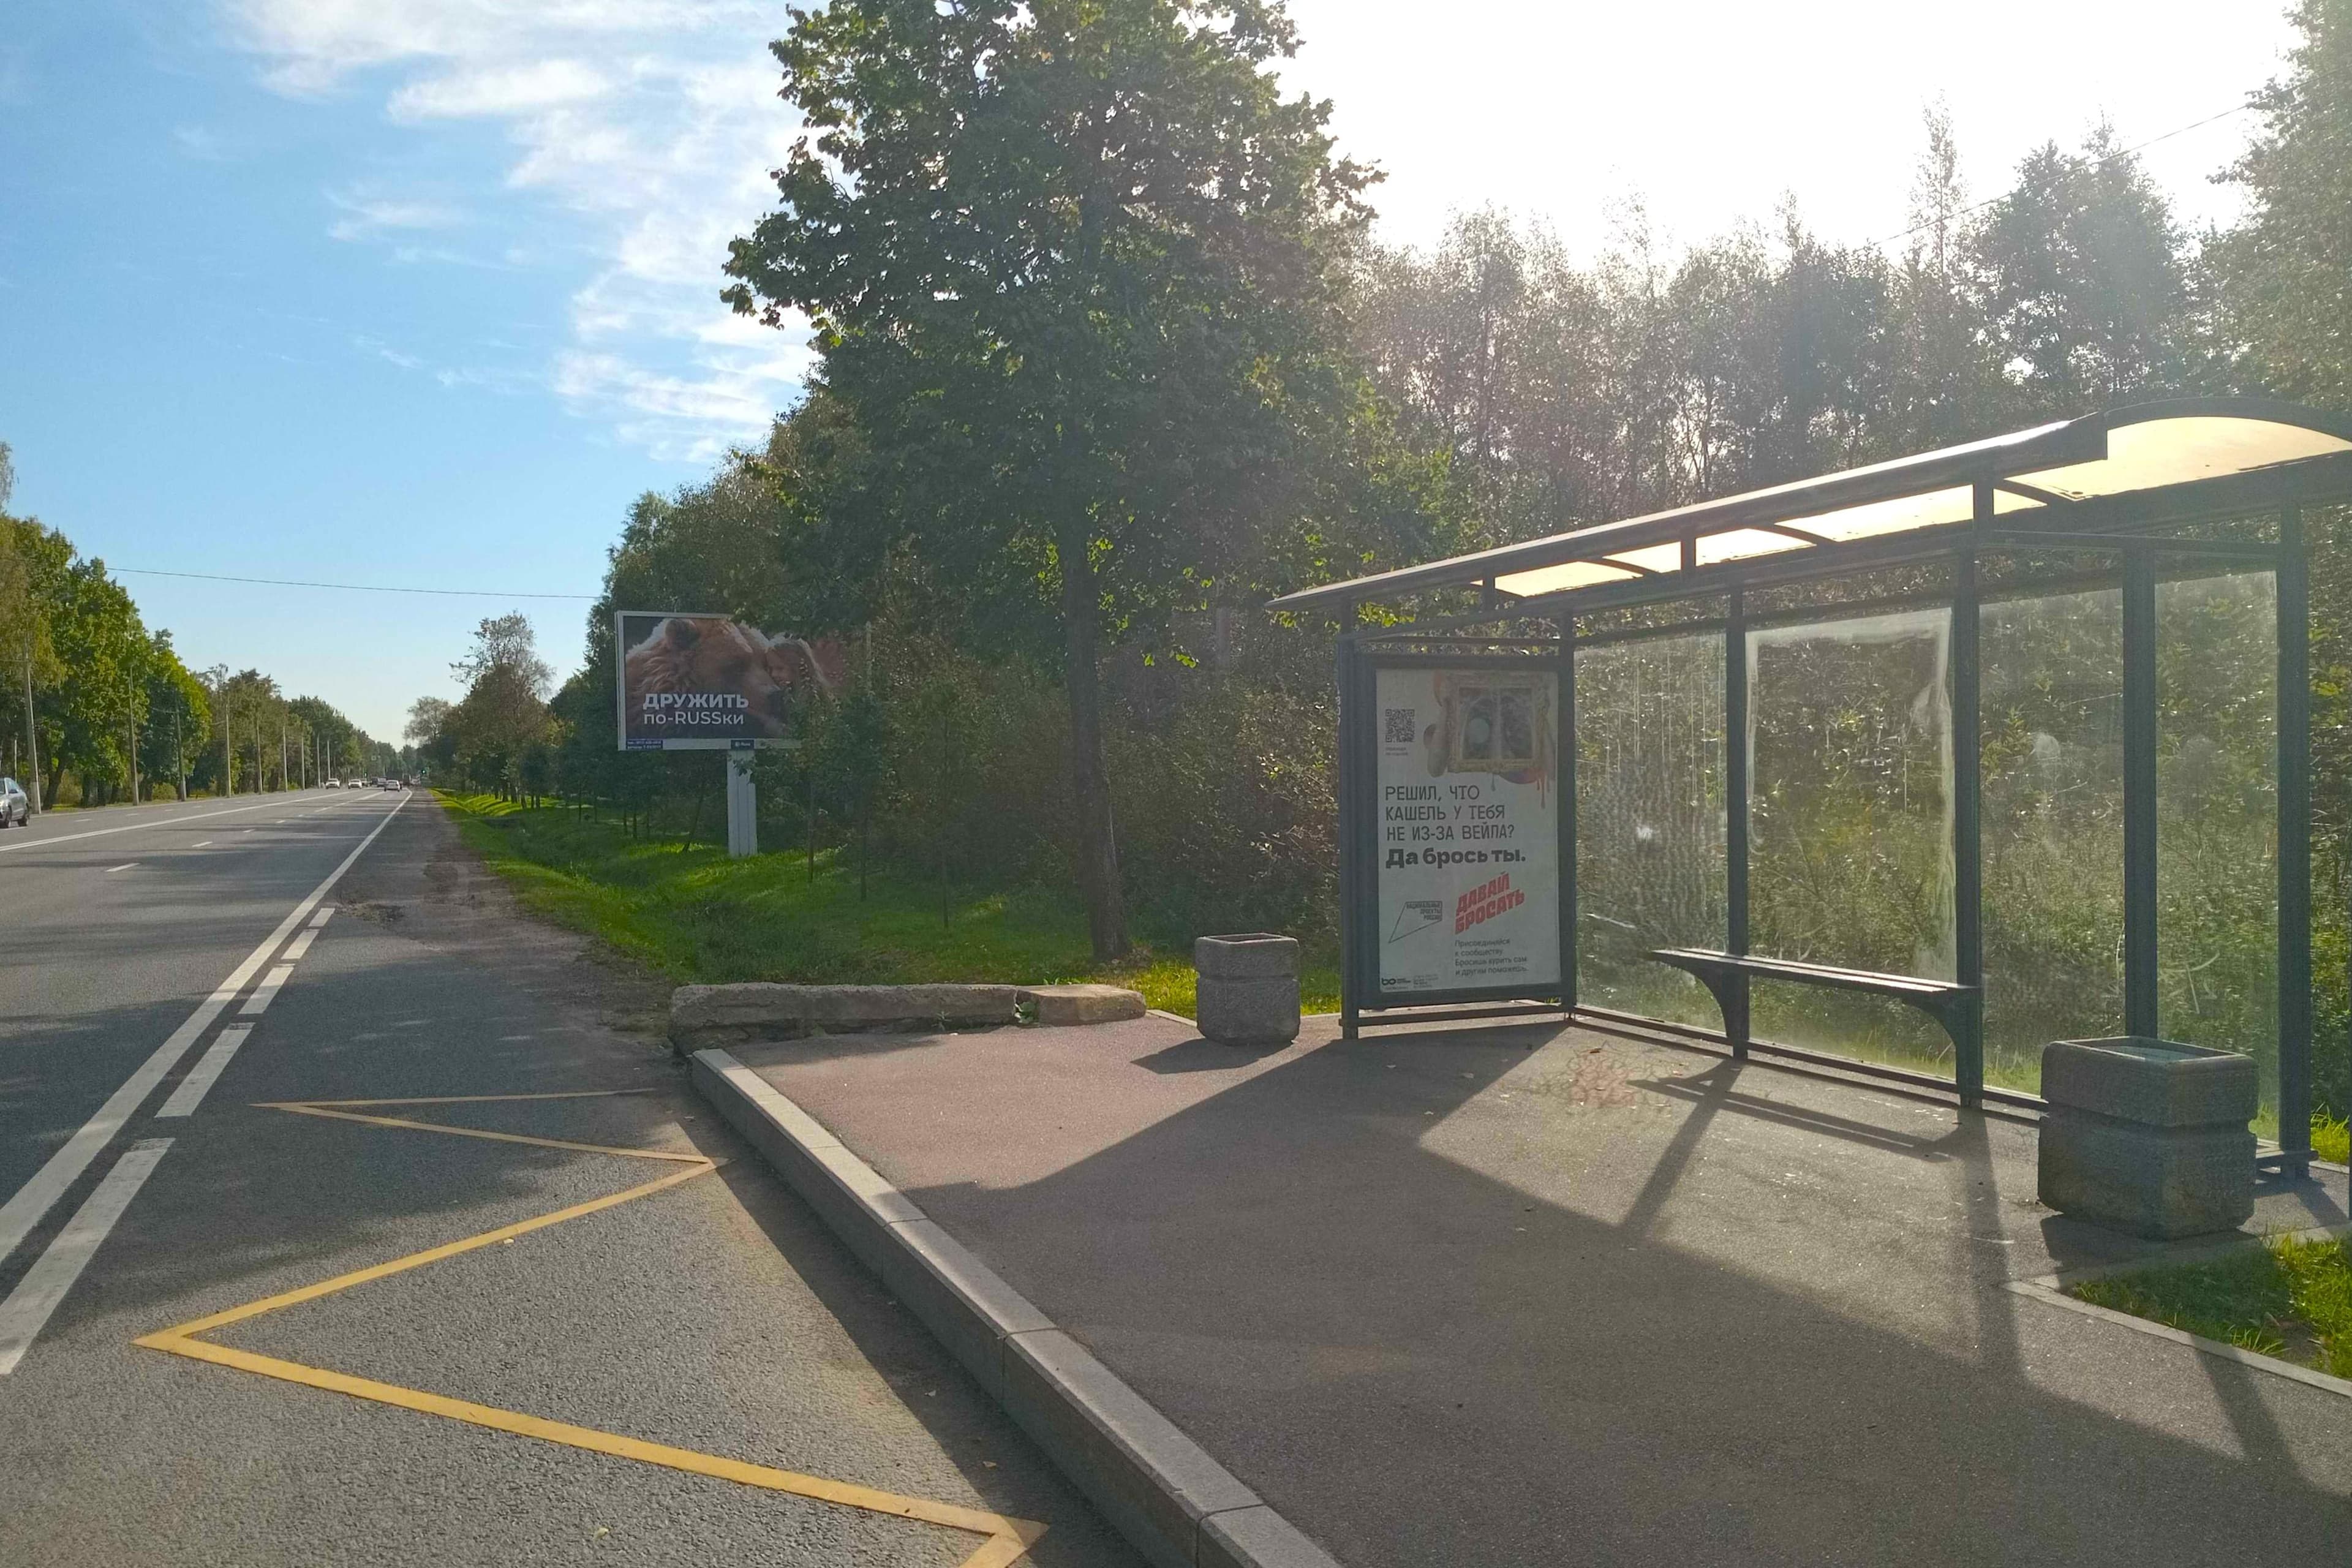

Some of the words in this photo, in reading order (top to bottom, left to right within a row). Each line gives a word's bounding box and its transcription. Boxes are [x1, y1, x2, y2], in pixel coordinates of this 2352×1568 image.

[643, 693, 749, 710] ДРУЖИТЬ
[1385, 786, 1441, 801] РЕШИЛ,
[1450, 785, 1480, 799] ЧТО
[1385, 806, 1446, 821] КАШЕЛЬ
[1454, 805, 1462, 819] У
[1387, 827, 1405, 841] НЕ
[1412, 826, 1454, 840] ИЗ-ЗА
[1462, 822, 1515, 840] ВЕЙПА?
[1385, 848, 1418, 869] Да
[1423, 848, 1488, 868] брось
[1491, 849, 1526, 862] ты.
[1456, 870, 1510, 916] ДАВАЙ
[1455, 888, 1525, 935] БРОСАТЬ
[1461, 968, 1487, 976] другим
